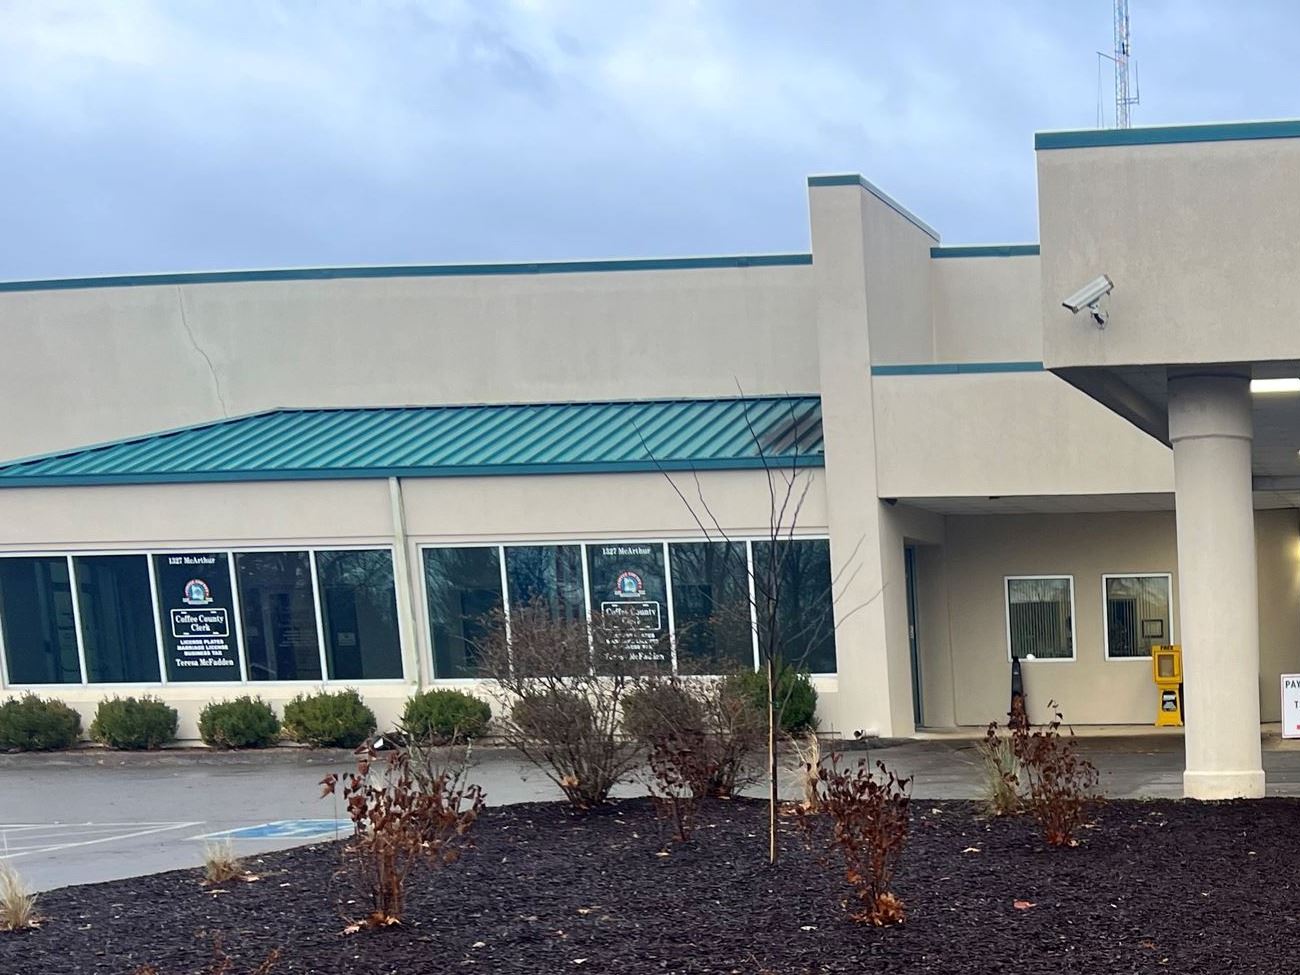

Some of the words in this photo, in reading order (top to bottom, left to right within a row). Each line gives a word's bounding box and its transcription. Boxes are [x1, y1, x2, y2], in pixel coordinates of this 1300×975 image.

[176, 614, 198, 623] Coffee
[199, 614, 224, 624] County
[191, 624, 210, 632] Clerk
[200, 658, 234, 666] McFadden
